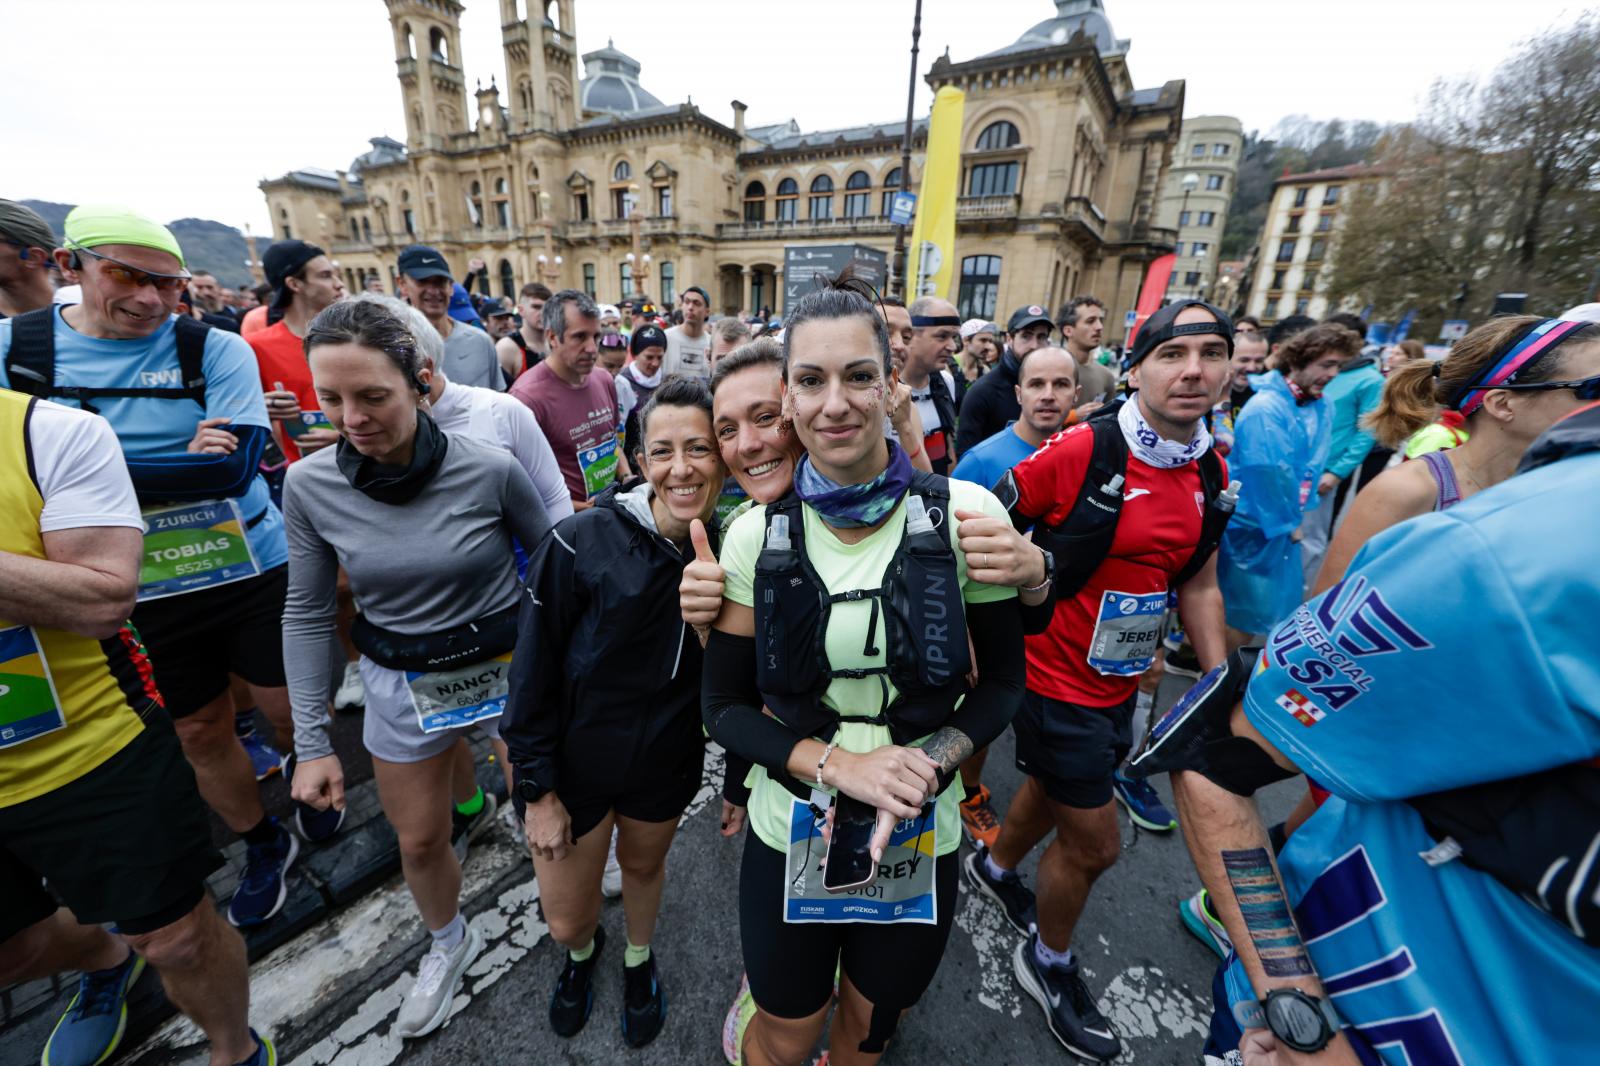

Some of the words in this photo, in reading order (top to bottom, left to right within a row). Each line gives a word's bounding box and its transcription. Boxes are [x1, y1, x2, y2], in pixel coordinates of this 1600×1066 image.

[1086, 496, 1117, 514] SALOMON
[156, 510, 216, 529] ZURICH
[147, 537, 231, 563] TOBIAS
[175, 559, 213, 575] 5525
[1272, 617, 1362, 713] ULSA
[436, 666, 502, 696] NANCY
